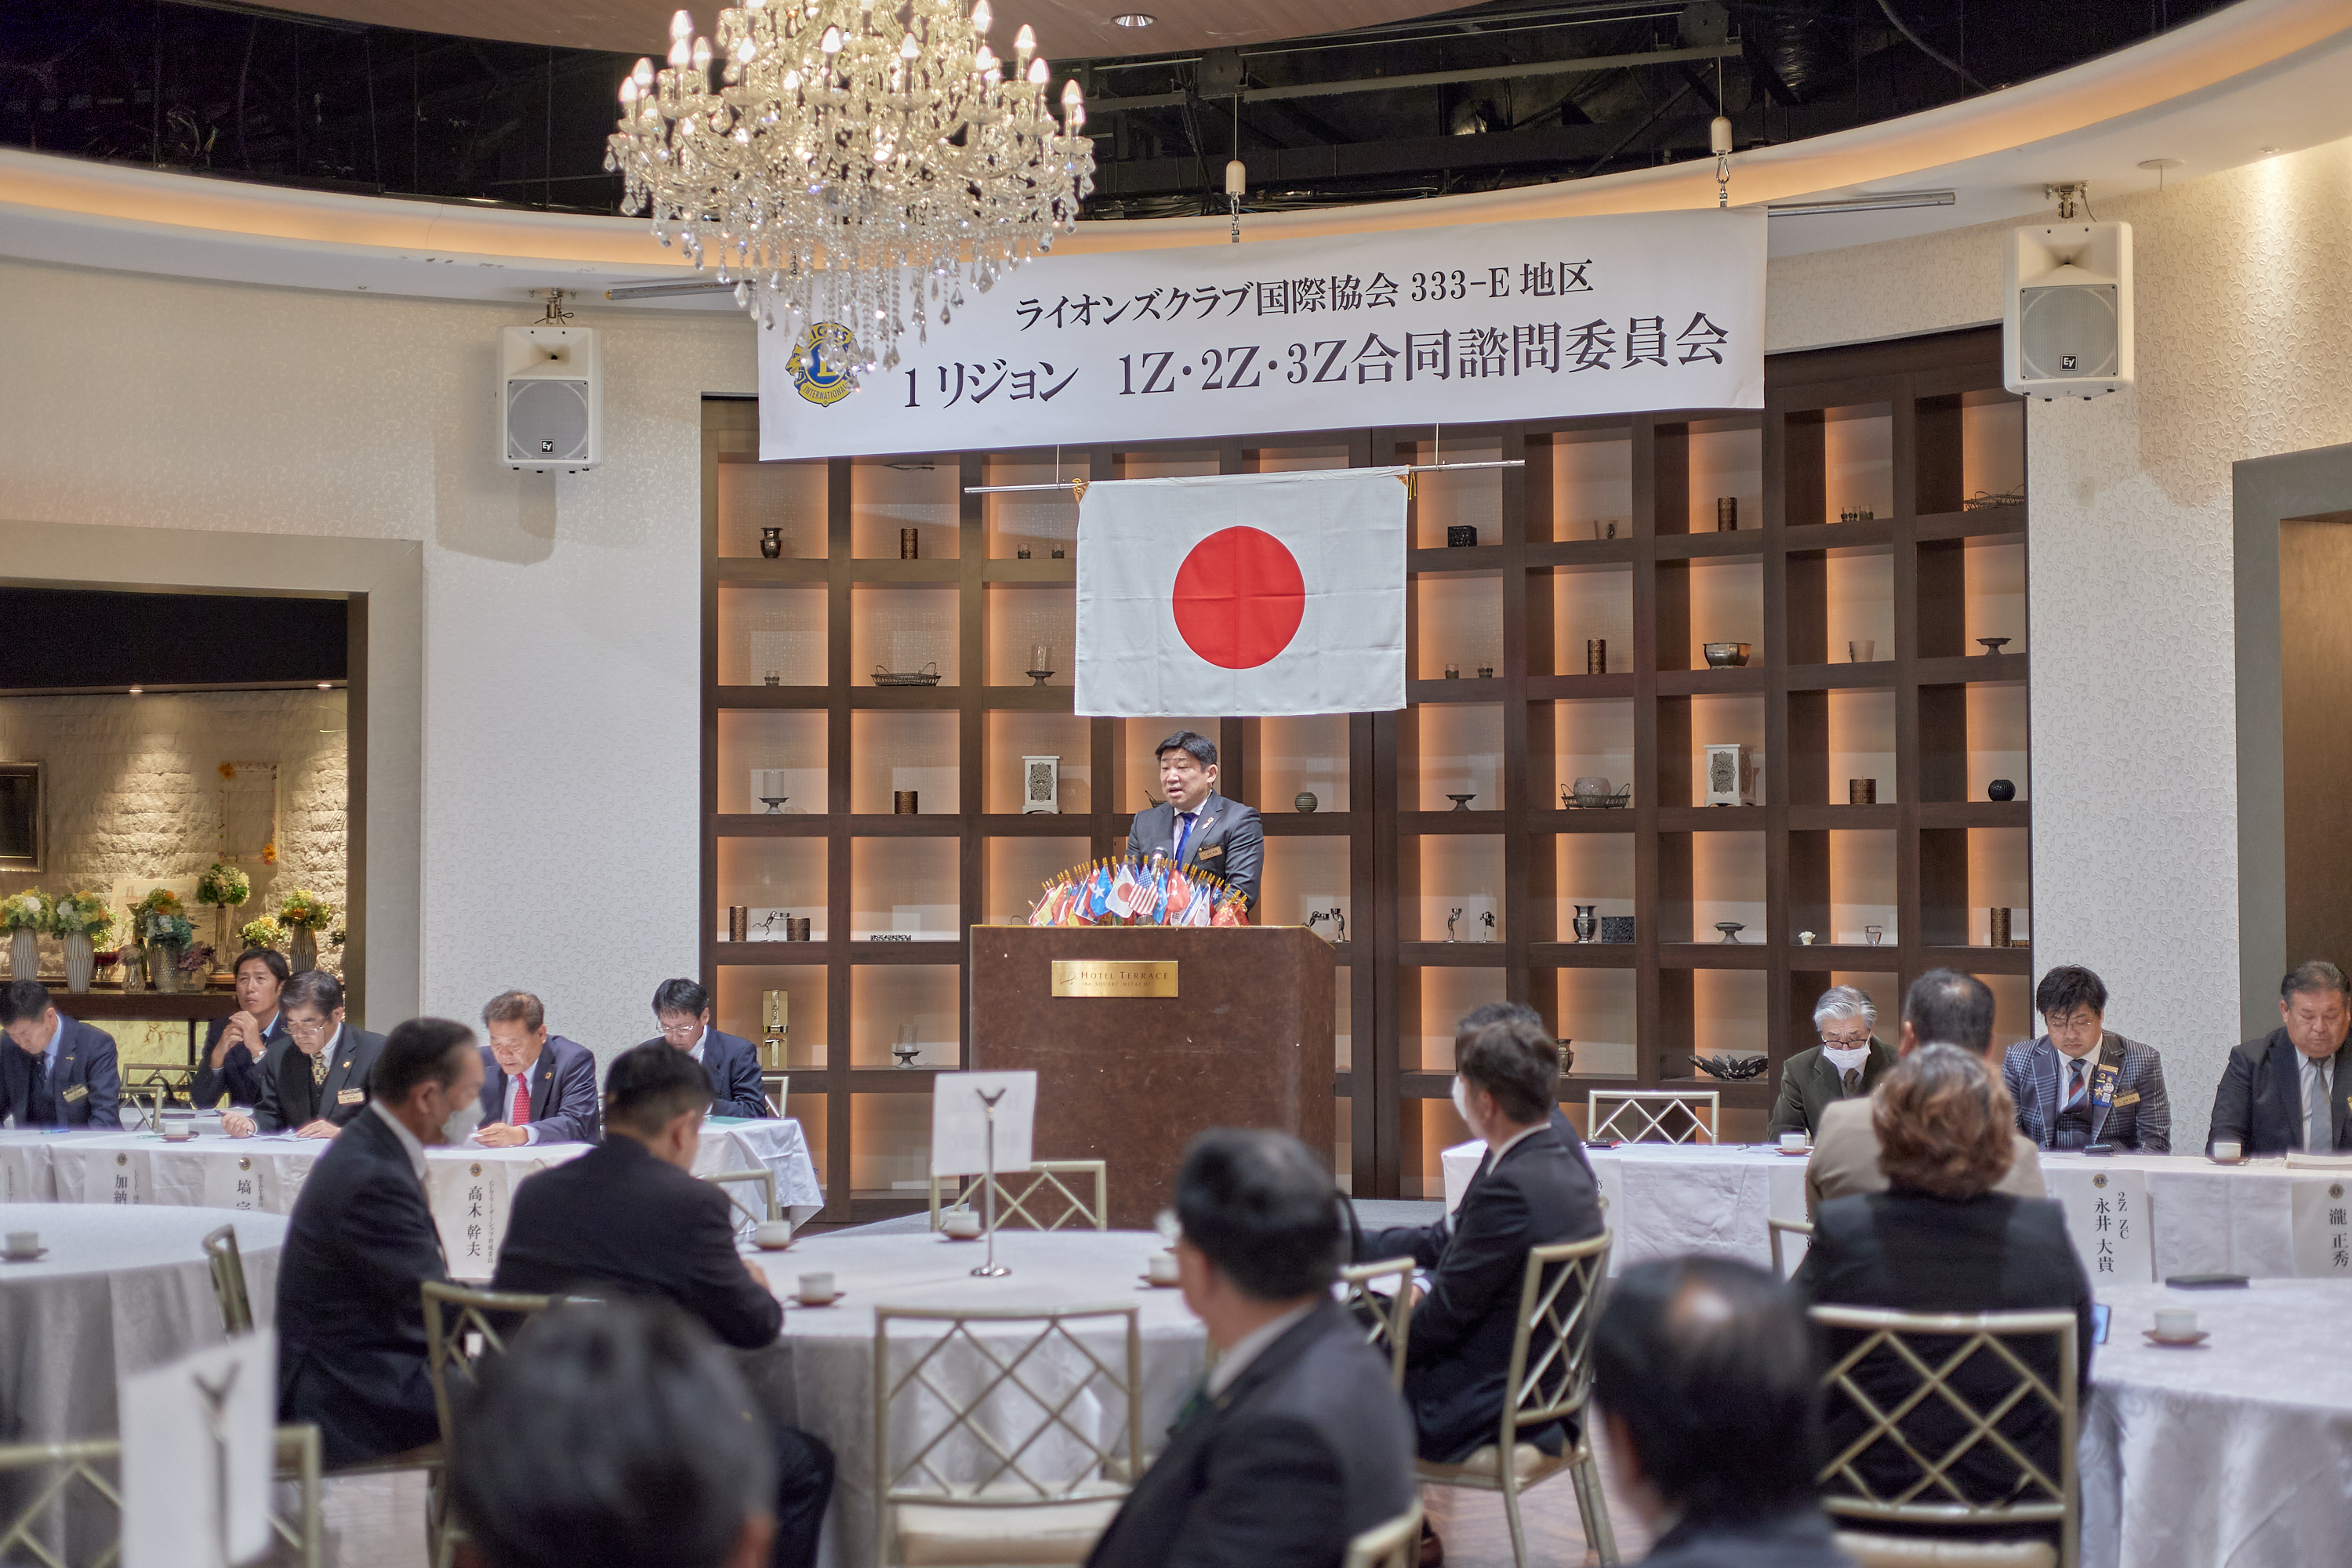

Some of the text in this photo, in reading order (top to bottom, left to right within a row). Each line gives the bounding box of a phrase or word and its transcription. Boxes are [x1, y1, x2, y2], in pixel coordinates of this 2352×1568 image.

[1017, 259, 1594, 332] ライオンズクラブ国際協会 333-E 地区
[938, 358, 1079, 409] リジョン
[1119, 311, 1729, 395] 1Z・2Z・3Z合同諮問委員会
[114, 1174, 128, 1205] 加納
[237, 1179, 252, 1195] 塙
[466, 1185, 482, 1257] 高木 幹夫
[2094, 1197, 2114, 1272] 永井 大貴
[2329, 1208, 2349, 1267] 瀧 正秀
